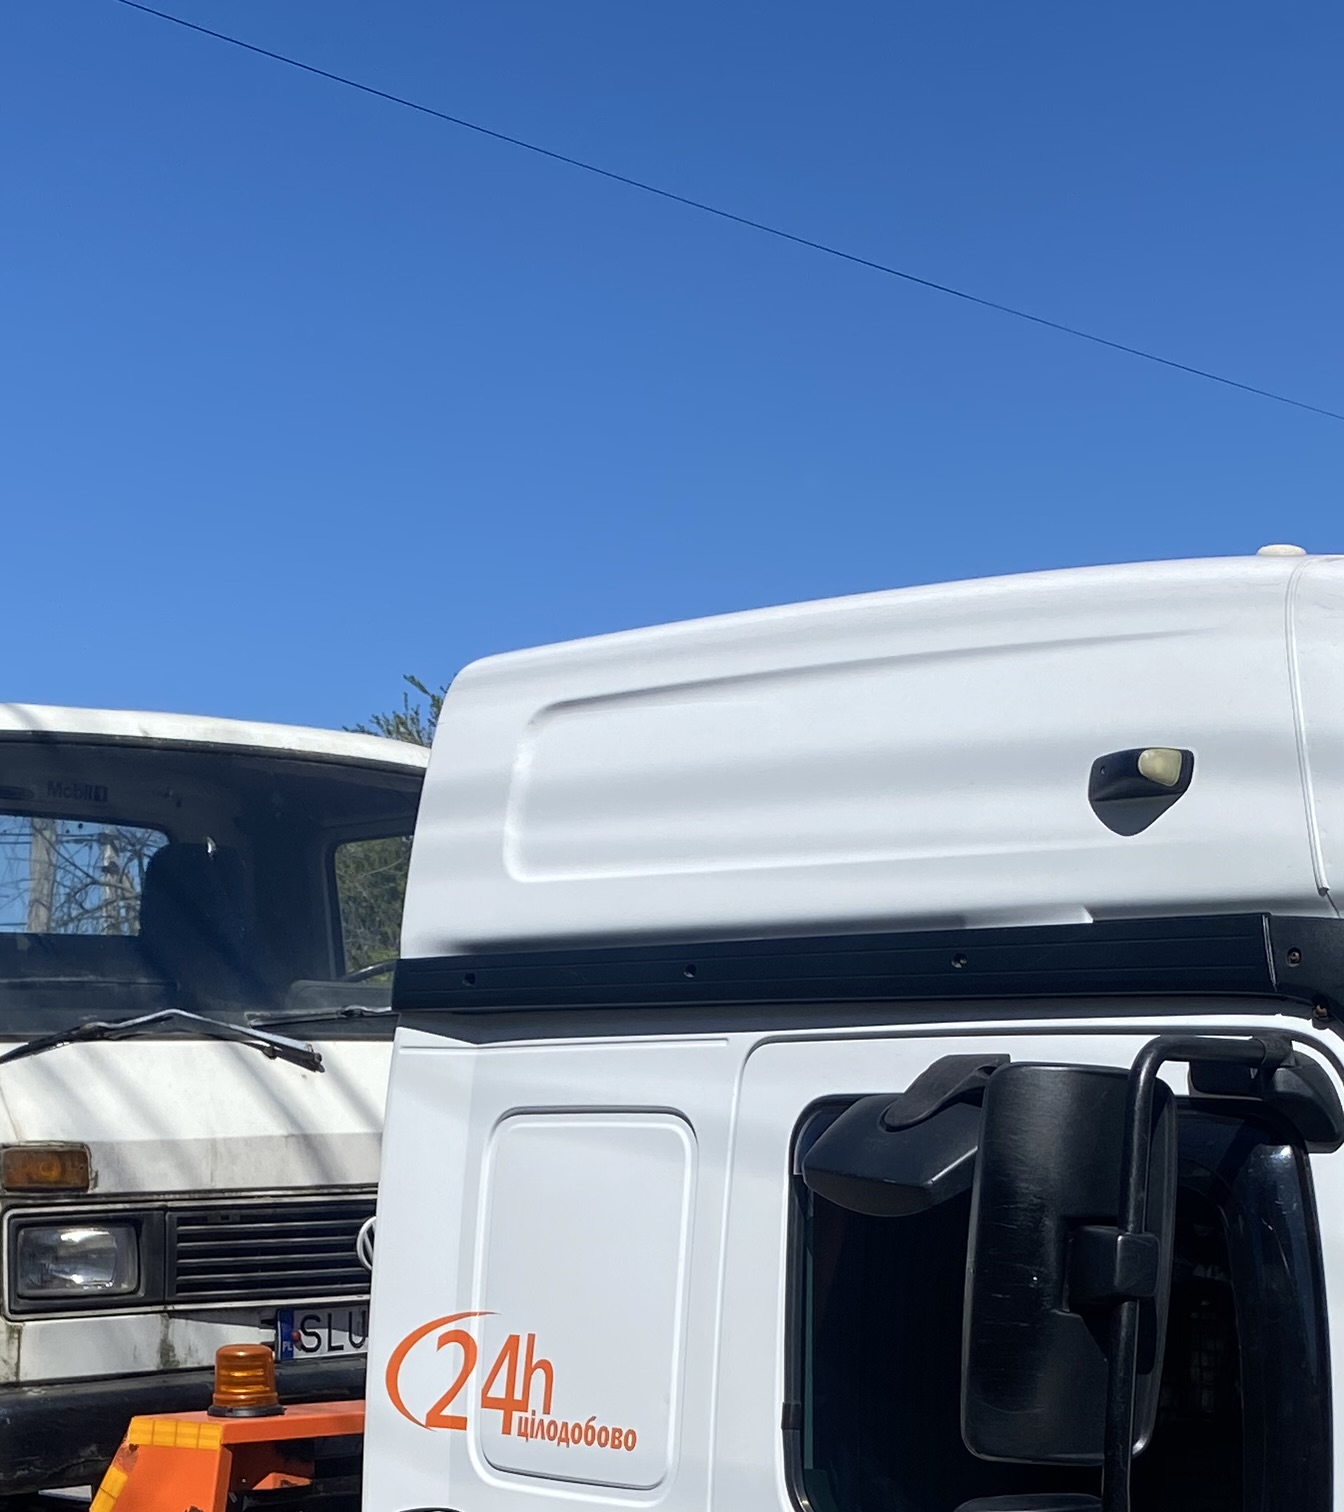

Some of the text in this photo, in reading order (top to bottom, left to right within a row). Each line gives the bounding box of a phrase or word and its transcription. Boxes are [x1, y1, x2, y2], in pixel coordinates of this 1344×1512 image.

[282, 1341, 293, 1352] PL
[300, 1310, 367, 1353] SLU
[424, 1332, 555, 1436] 24h
[517, 1409, 638, 1452] цілодобово
